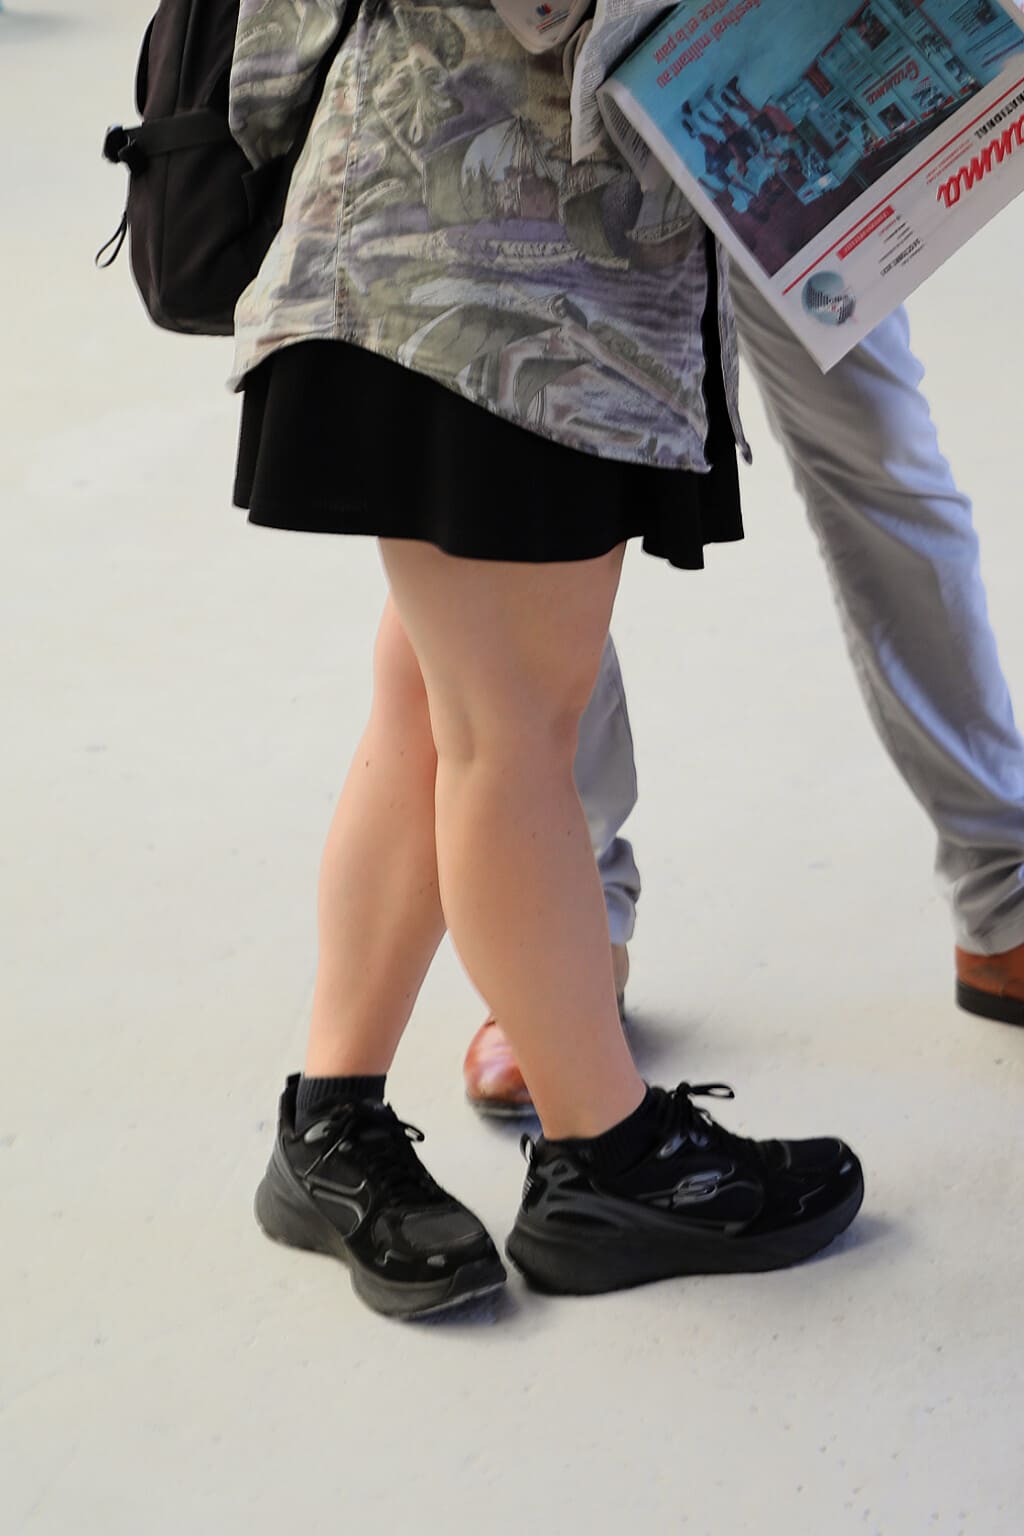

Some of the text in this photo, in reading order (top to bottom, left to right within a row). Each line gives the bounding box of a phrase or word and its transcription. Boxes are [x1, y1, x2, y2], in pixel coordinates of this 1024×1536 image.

[686, 17, 699, 35] et
[653, 36, 677, 65] paix
[669, 33, 712, 77] militant
[656, 70, 673, 89] au
